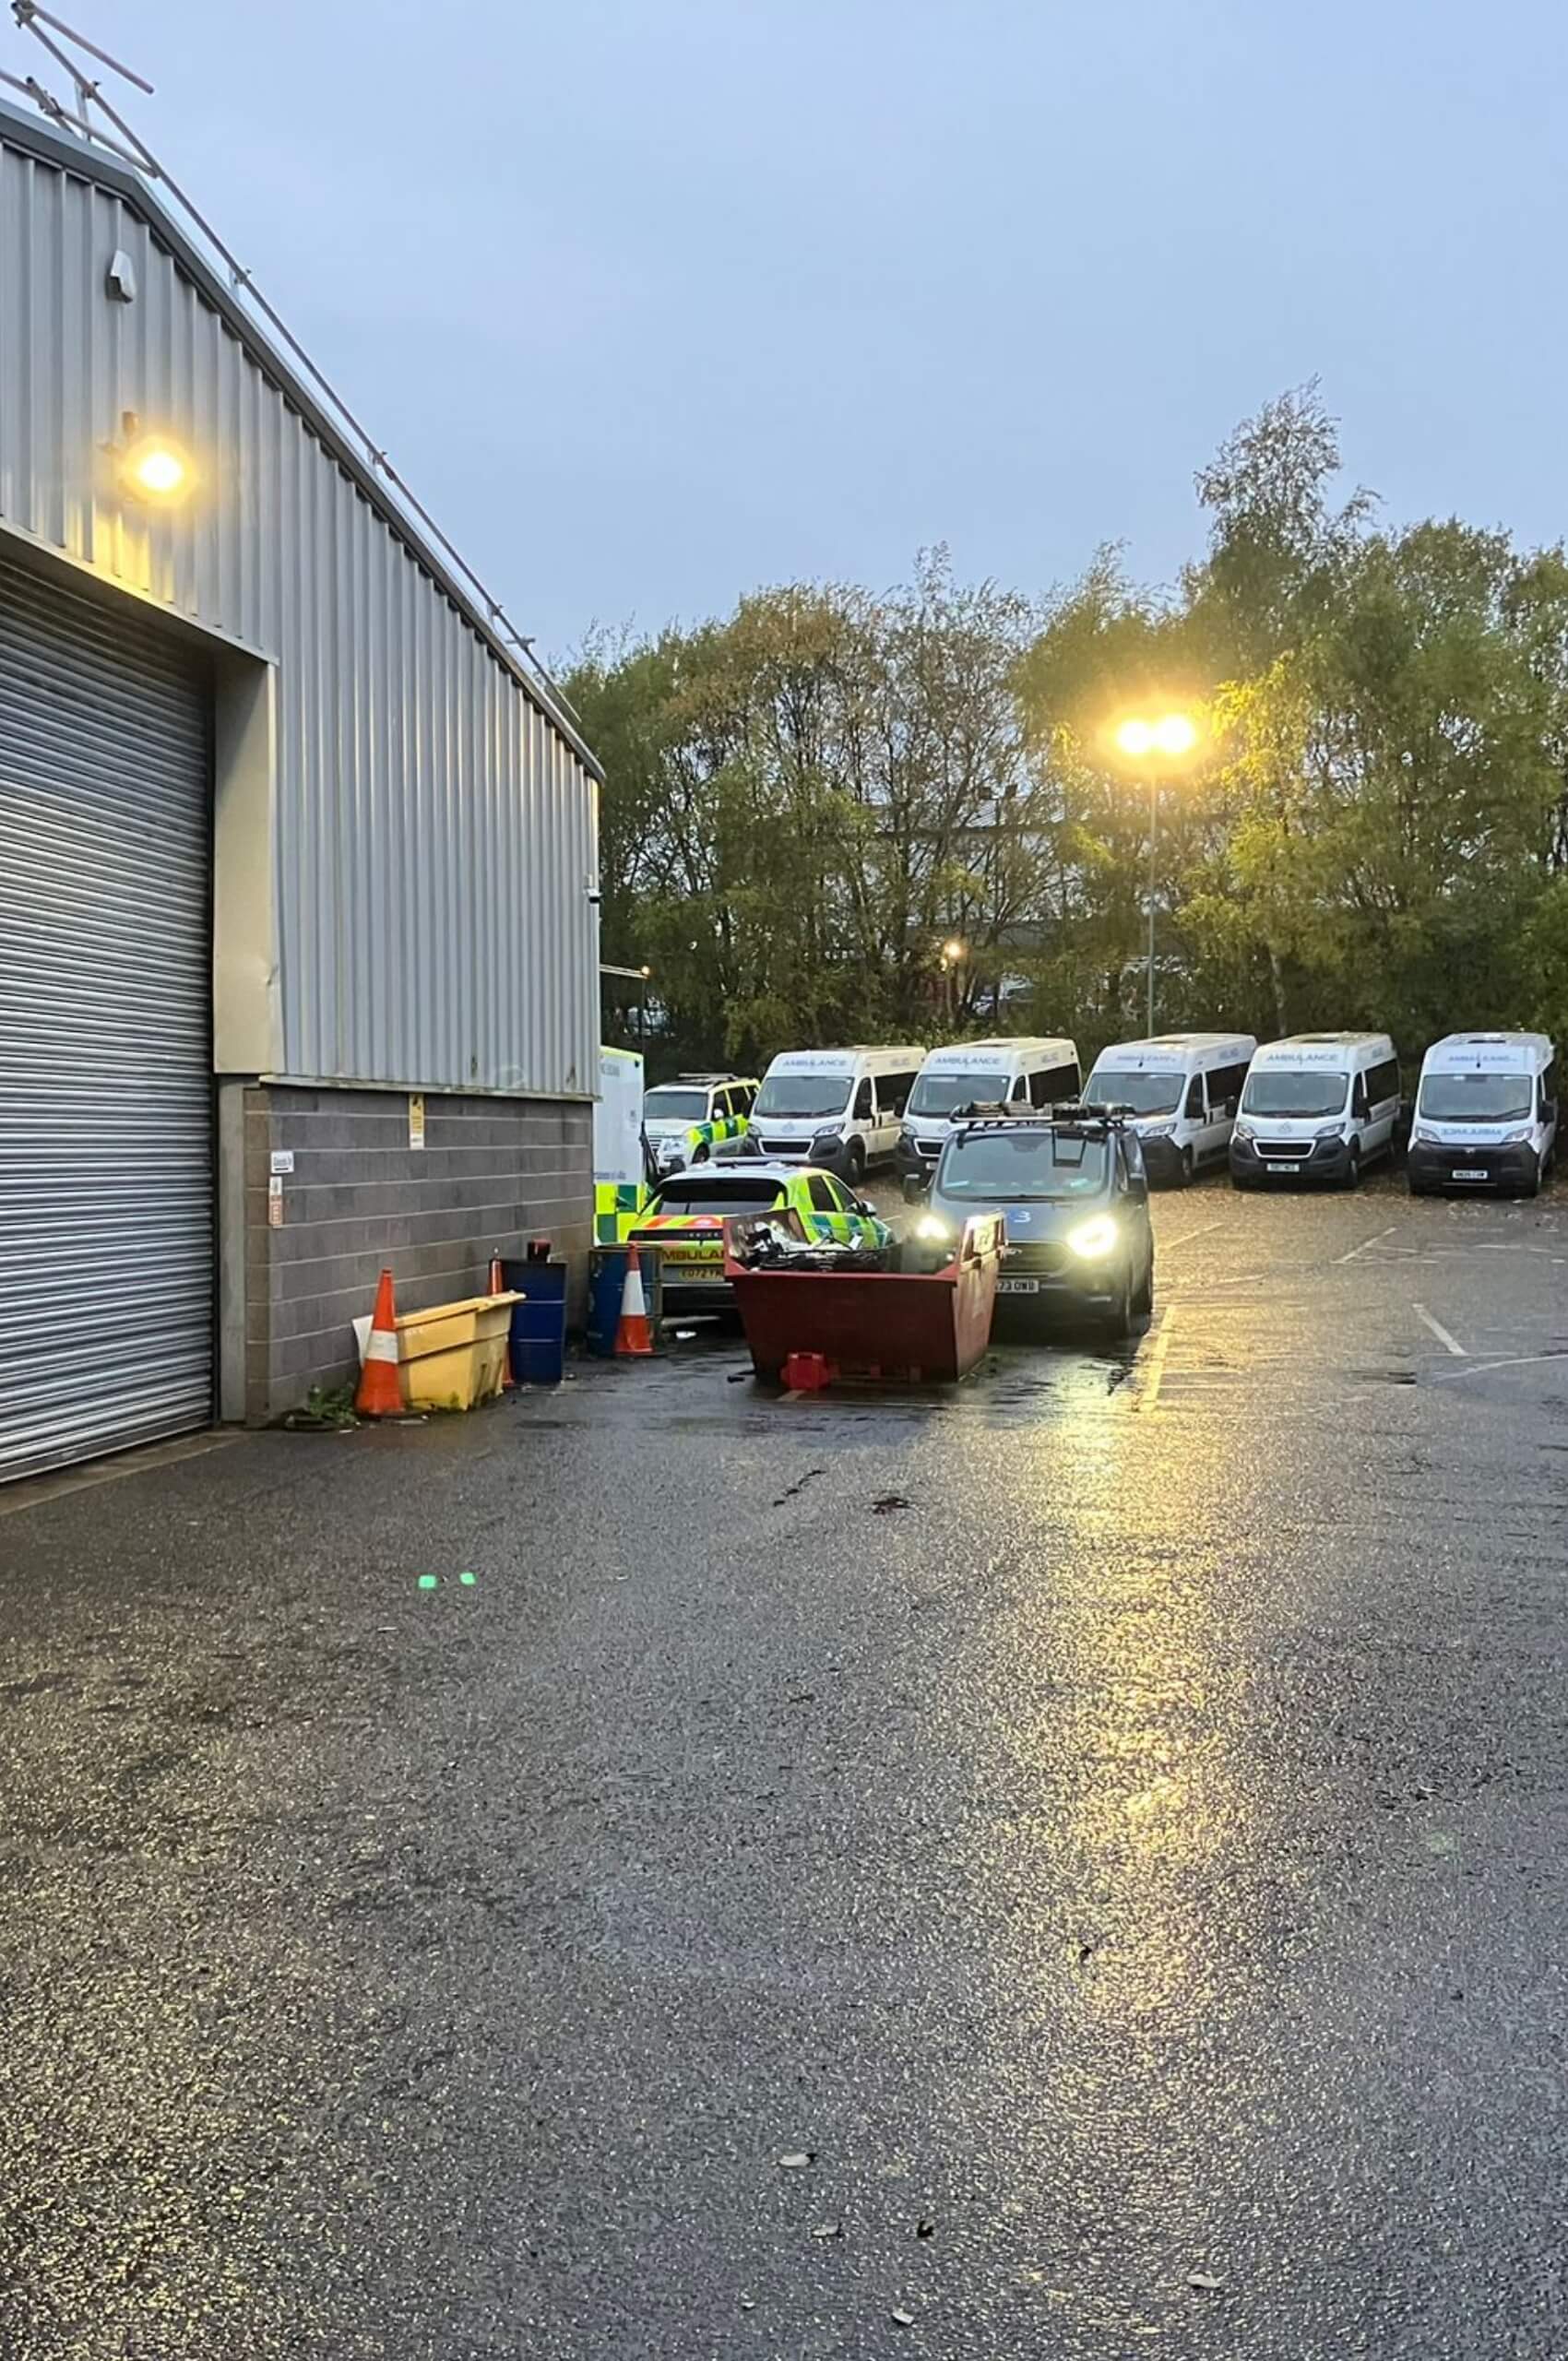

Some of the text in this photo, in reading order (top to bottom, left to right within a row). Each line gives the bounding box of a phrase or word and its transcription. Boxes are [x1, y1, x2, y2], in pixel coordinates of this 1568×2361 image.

[935, 1056, 1000, 1065] AMBULANCE
[1267, 1052, 1338, 1062] AMBULANCE
[662, 1249, 723, 1261] MBULA
